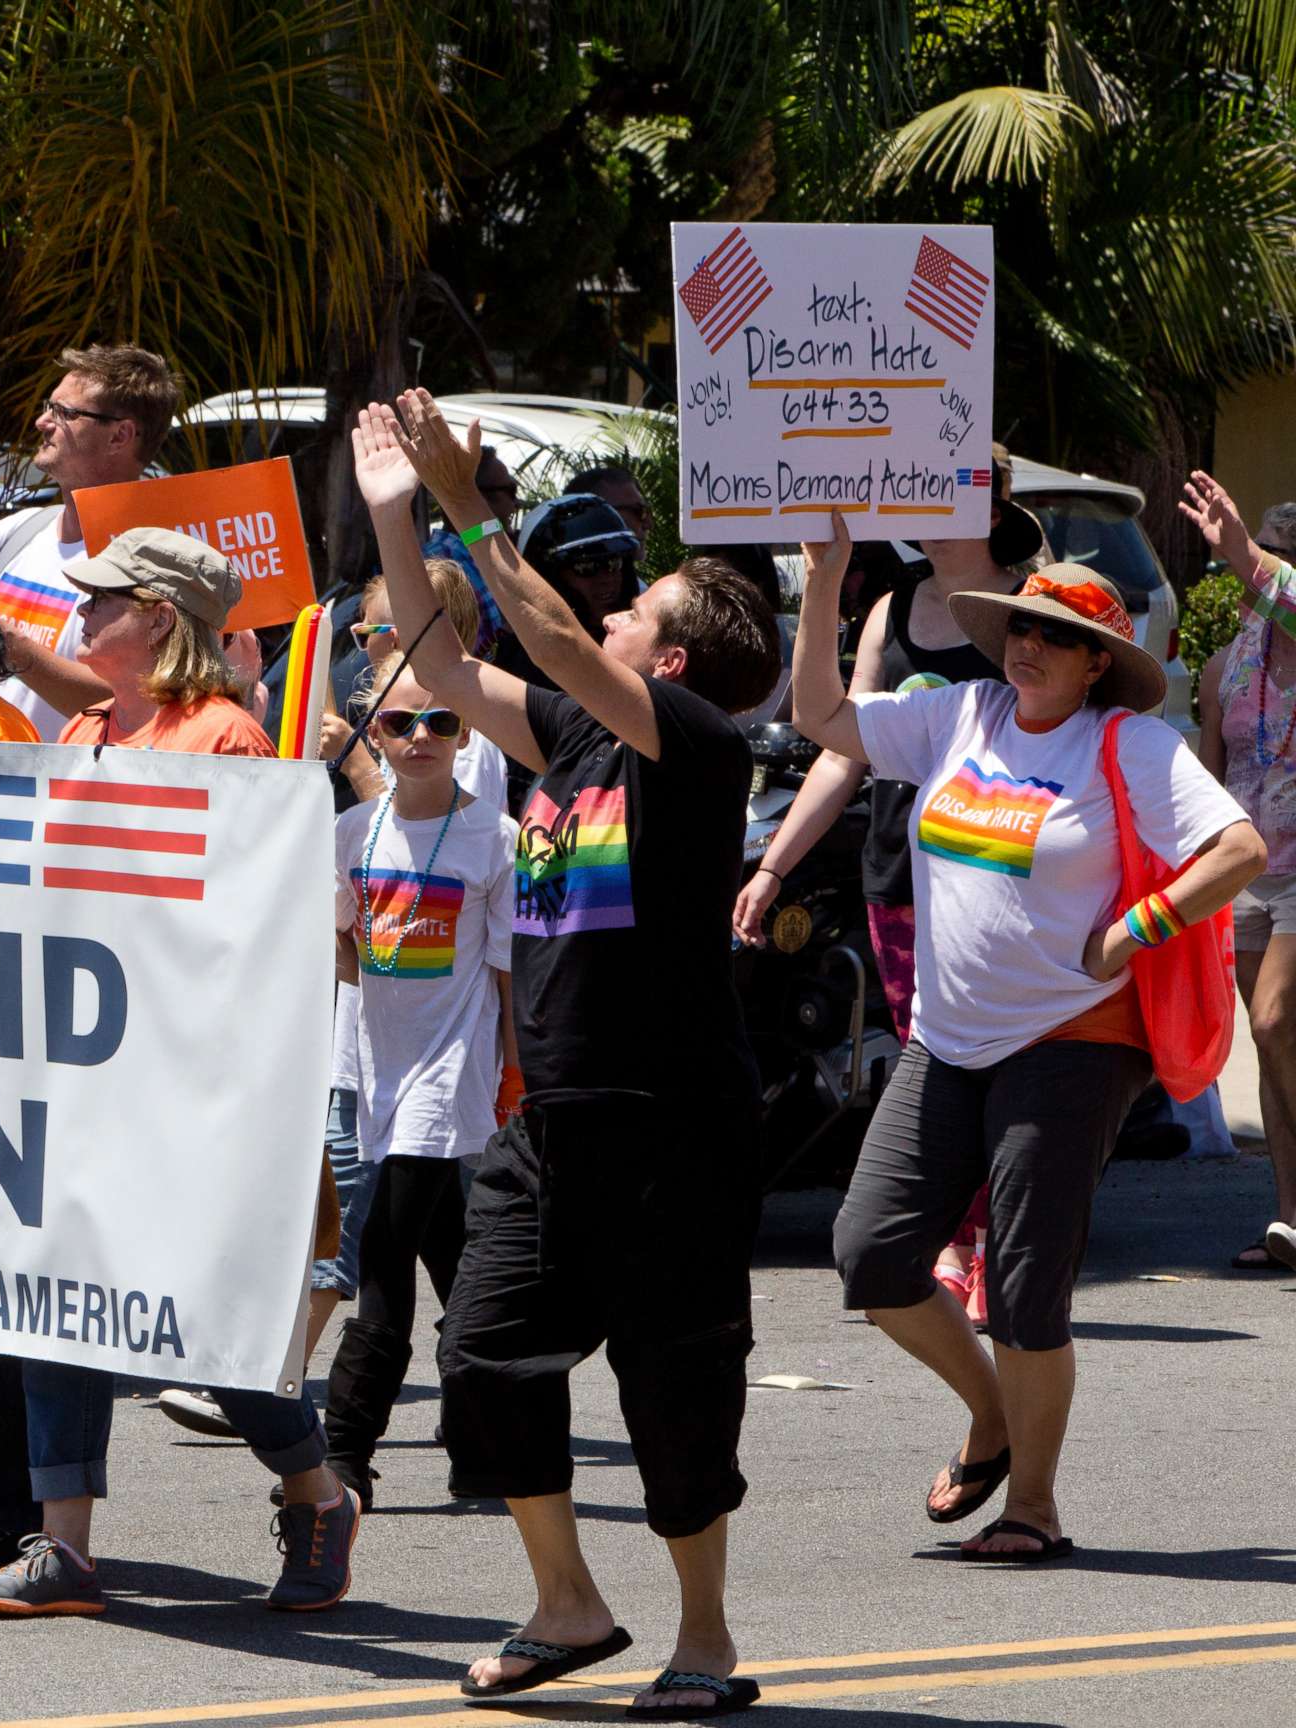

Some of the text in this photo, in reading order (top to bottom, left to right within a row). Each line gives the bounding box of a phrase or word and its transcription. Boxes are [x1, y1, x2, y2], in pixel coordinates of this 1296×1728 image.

[807, 281, 873, 327] text:
[742, 324, 938, 381] Disarm Hate
[686, 370, 722, 410] JOIN
[939, 388, 973, 423] JOIN
[690, 458, 954, 506] Moms Demand Action
[216, 511, 277, 551] END
[990, 807, 1037, 833] HATE
